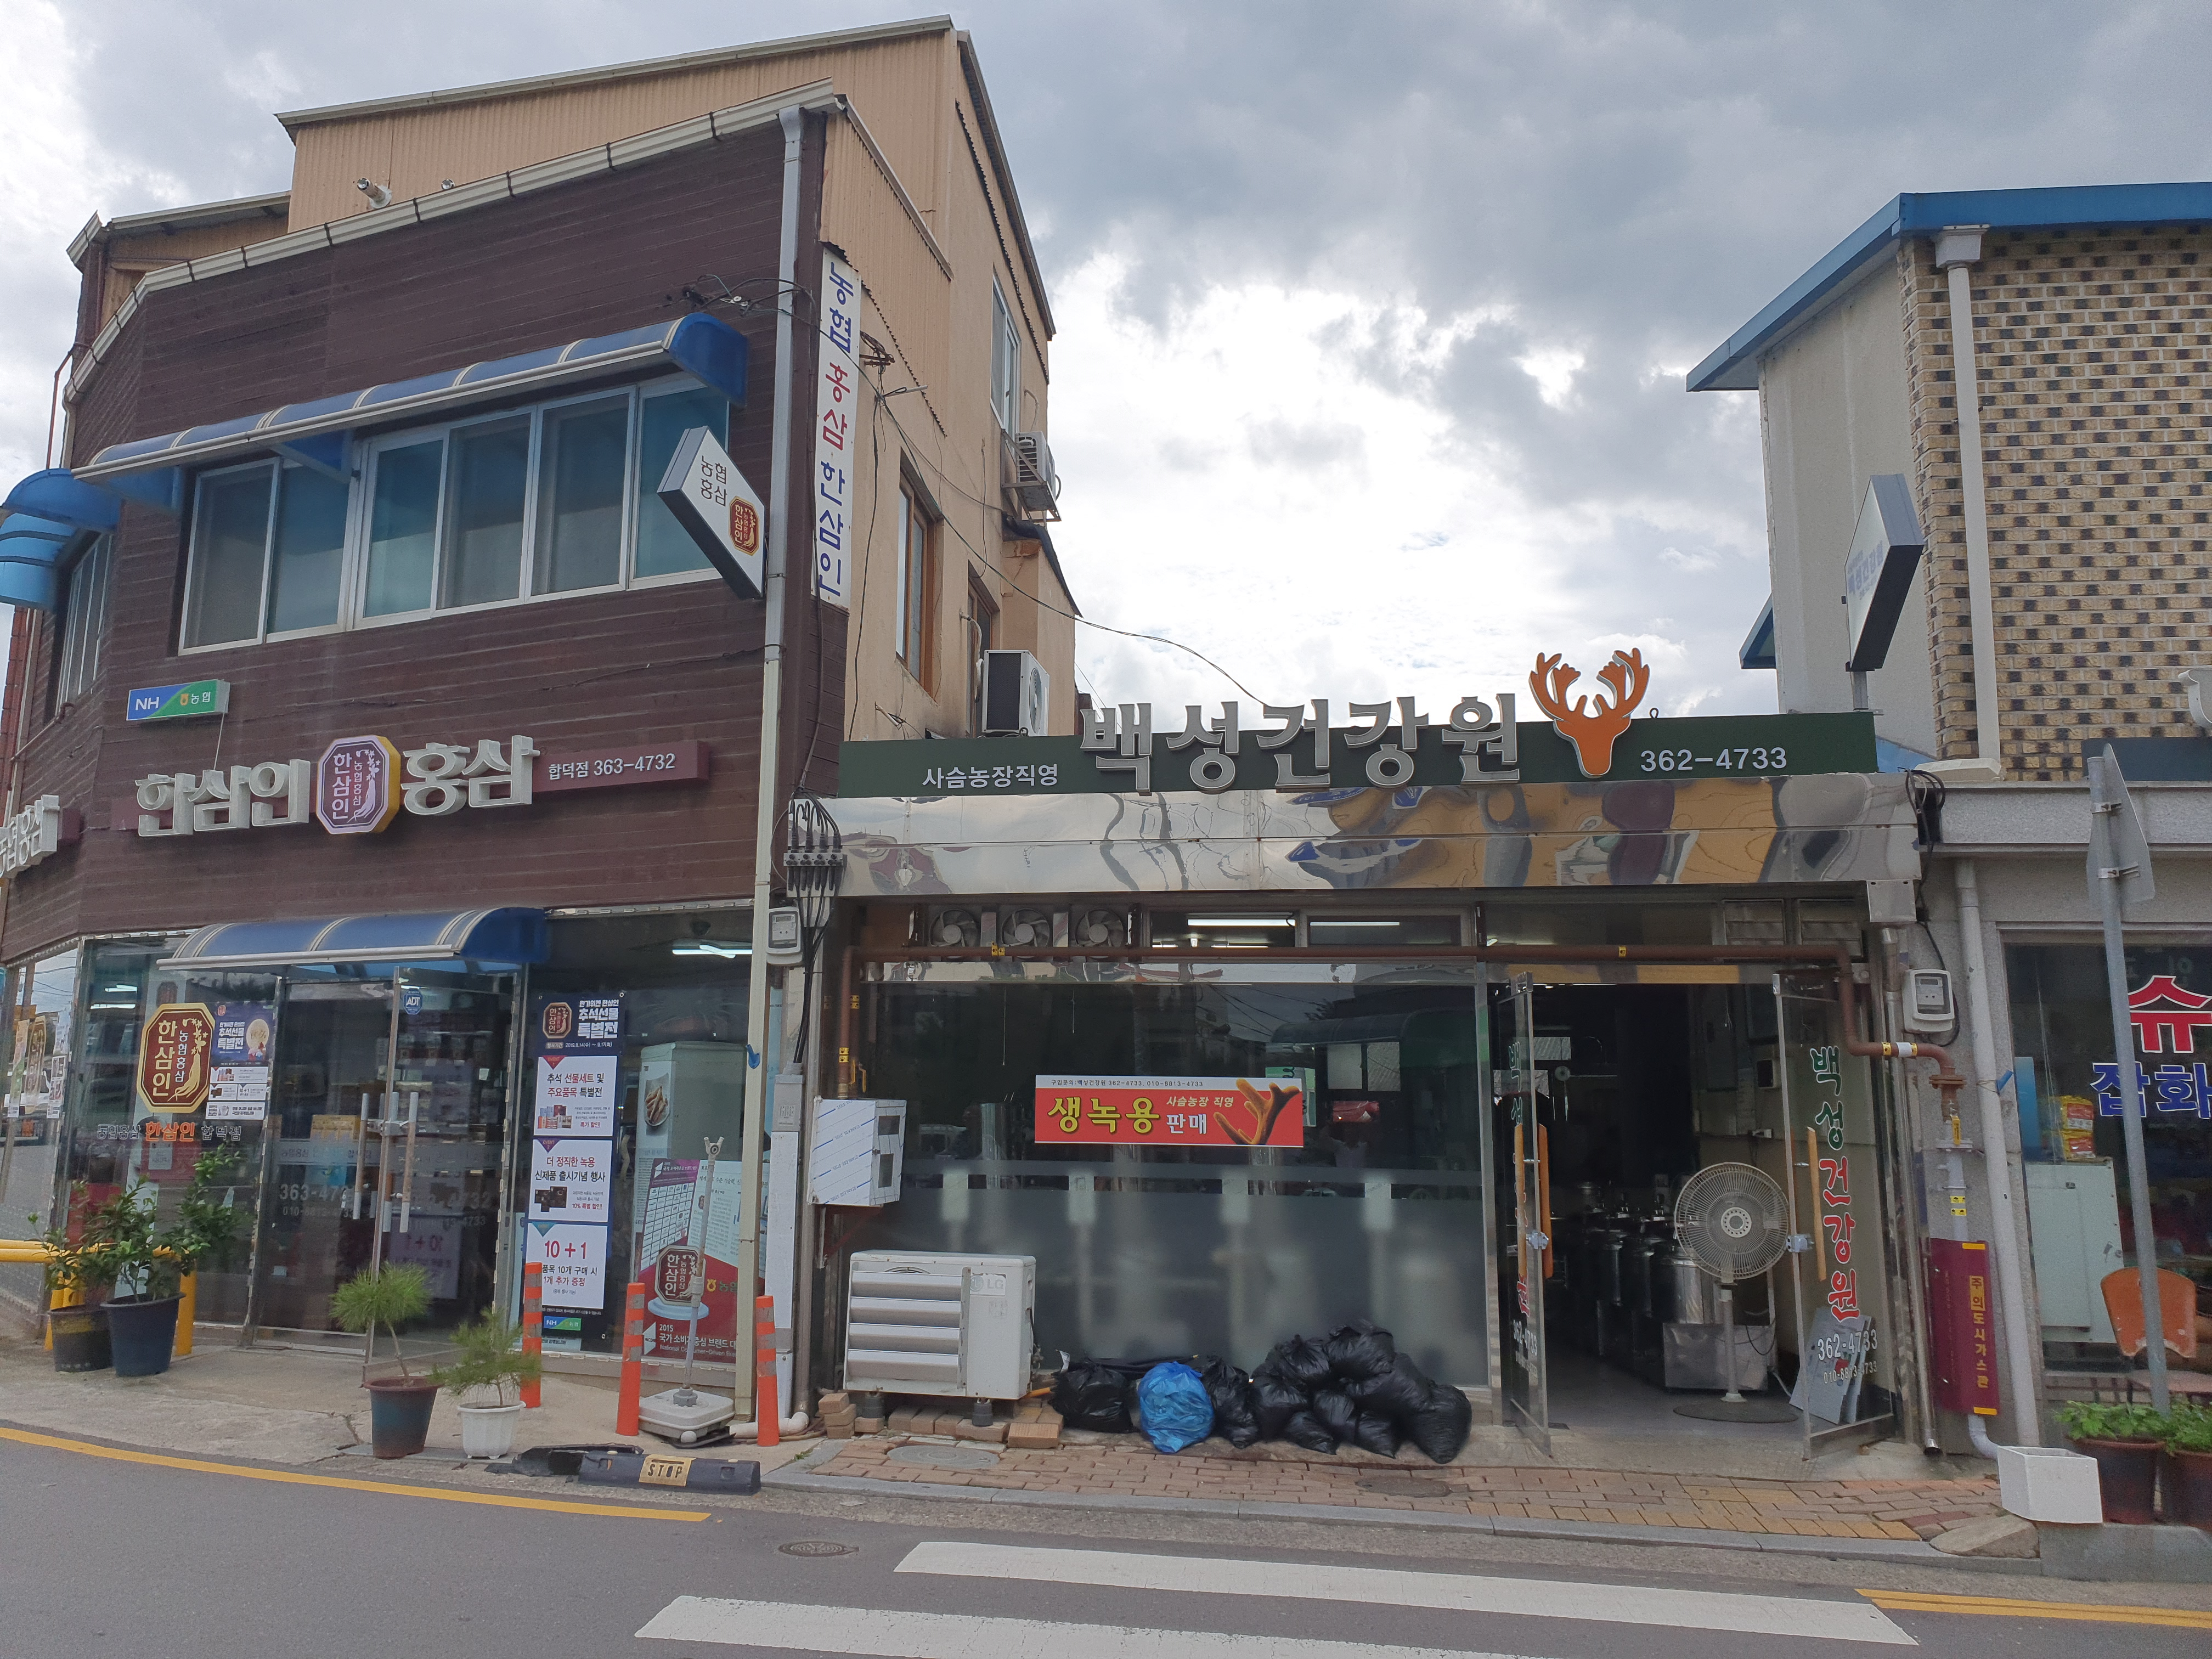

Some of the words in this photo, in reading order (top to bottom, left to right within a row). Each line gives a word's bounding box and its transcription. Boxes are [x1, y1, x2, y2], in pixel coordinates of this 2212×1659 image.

[828, 261, 854, 354] 농협
[822, 362, 850, 451] 홍삼
[735, 504, 744, 544] 한삼인
[818, 460, 843, 597] 한삼인
[135, 696, 160, 711] NH
[191, 691, 211, 704] 농협
[1080, 693, 1521, 796] 백성건강원
[549, 761, 590, 781] 합덕점
[593, 753, 676, 776] 363-4732
[1640, 746, 1787, 772] 362-4733
[332, 753, 352, 820] 한삼인
[353, 761, 363, 806] 농협홍삼
[400, 735, 541, 815] 홍삼
[922, 763, 1058, 789] 사슴농장직영
[135, 759, 311, 837] 한삼인
[406, 996, 421, 1006] ADT
[578, 1007, 619, 1021] 추석선물
[549, 1008, 557, 1034] 한삼인
[578, 1022, 618, 1039] 특별전
[175, 1030, 189, 1082] 농협홍삼
[217, 1037, 244, 1049] 특별전
[153, 1020, 178, 1096] 한삼인
[547, 1073, 562, 1084] 추석
[565, 1073, 594, 1084] 선물세트
[597, 1073, 605, 1084] 및
[547, 1087, 578, 1098] 주요품목
[579, 1087, 602, 1098] 특별전
[1166, 1096, 1209, 1108] 사슴농장
[1214, 1096, 1234, 1108] 직영
[1047, 1096, 1160, 1135] 생녹용
[1166, 1113, 1207, 1135] 판매
[96, 1124, 141, 1140] 농협홍삼
[145, 1121, 195, 1142] 한삼인
[201, 1125, 241, 1141] 합덕점
[546, 1156, 554, 1167] 더
[556, 1156, 578, 1167] 정직한
[580, 1157, 595, 1167] 녹용
[535, 1170, 557, 1181] 신제품
[559, 1171, 588, 1182] 출시기념
[591, 1172, 606, 1182] 행사
[1809, 1045, 1861, 1323] 백성건강원
[543, 1276, 553, 1285] 1개
[556, 1276, 569, 1285] 추가
[572, 1277, 585, 1286] 증정
[558, 1266, 572, 1275] 10개
[574, 1266, 588, 1276] 구매
[590, 1267, 598, 1276] 시
[665, 1254, 680, 1296] 한삼인
[988, 1278, 1003, 1289] LG
[1971, 1276, 1984, 1310] 주의
[659, 1333, 673, 1344] 국가
[708, 1338, 729, 1348] 브랜드
[1818, 1329, 1877, 1361] 362-4733
[647, 1464, 684, 1479] STOP
